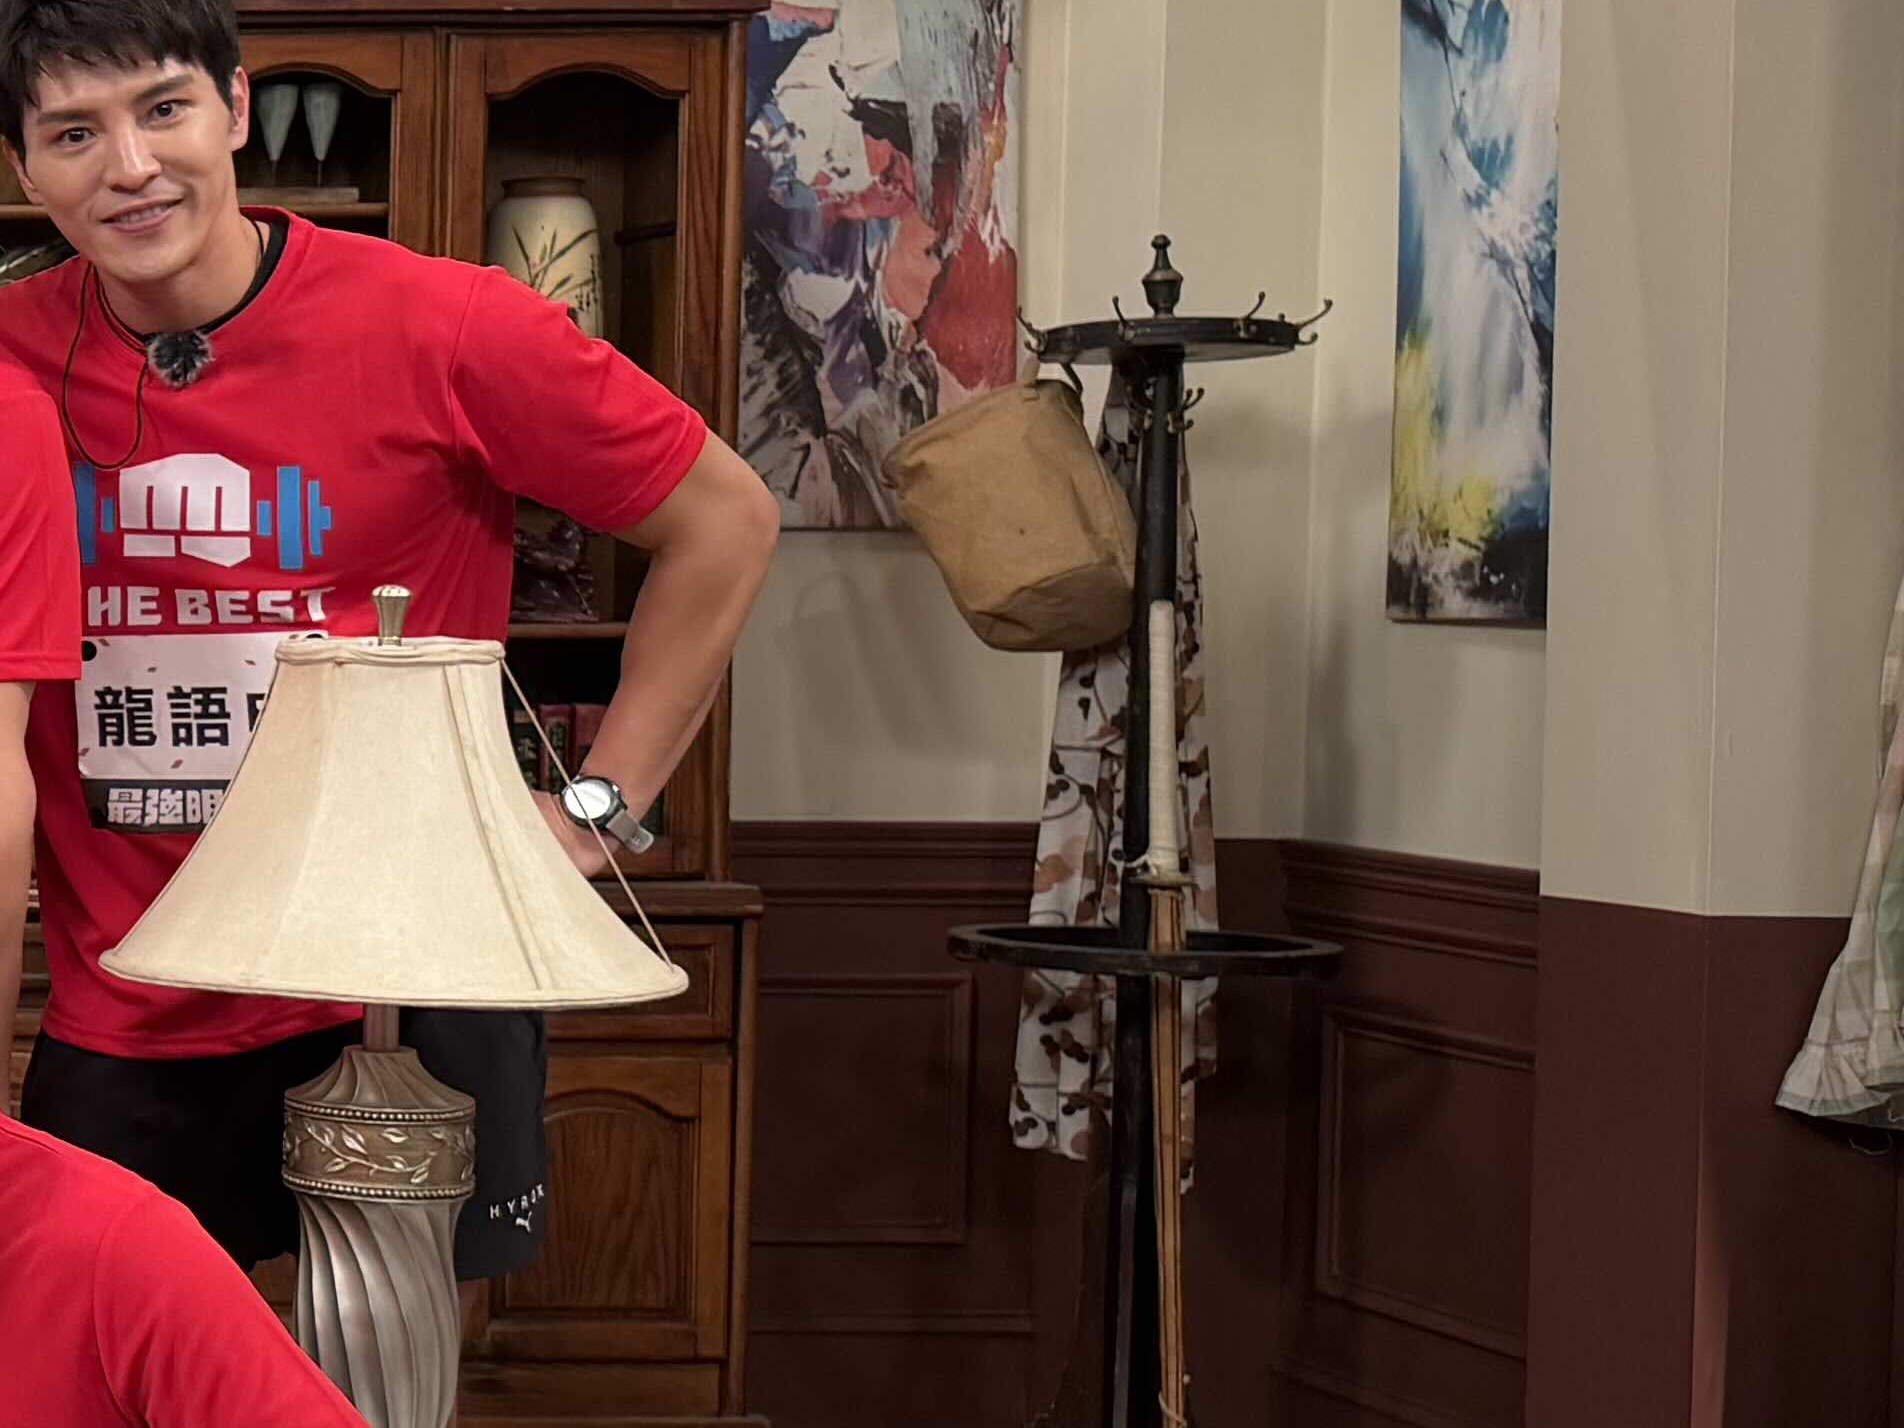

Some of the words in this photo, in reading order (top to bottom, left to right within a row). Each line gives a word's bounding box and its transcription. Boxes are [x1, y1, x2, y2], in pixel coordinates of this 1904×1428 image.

[87, 585, 162, 627] HE
[174, 585, 337, 625] BEST
[106, 787, 226, 826] 最強明
